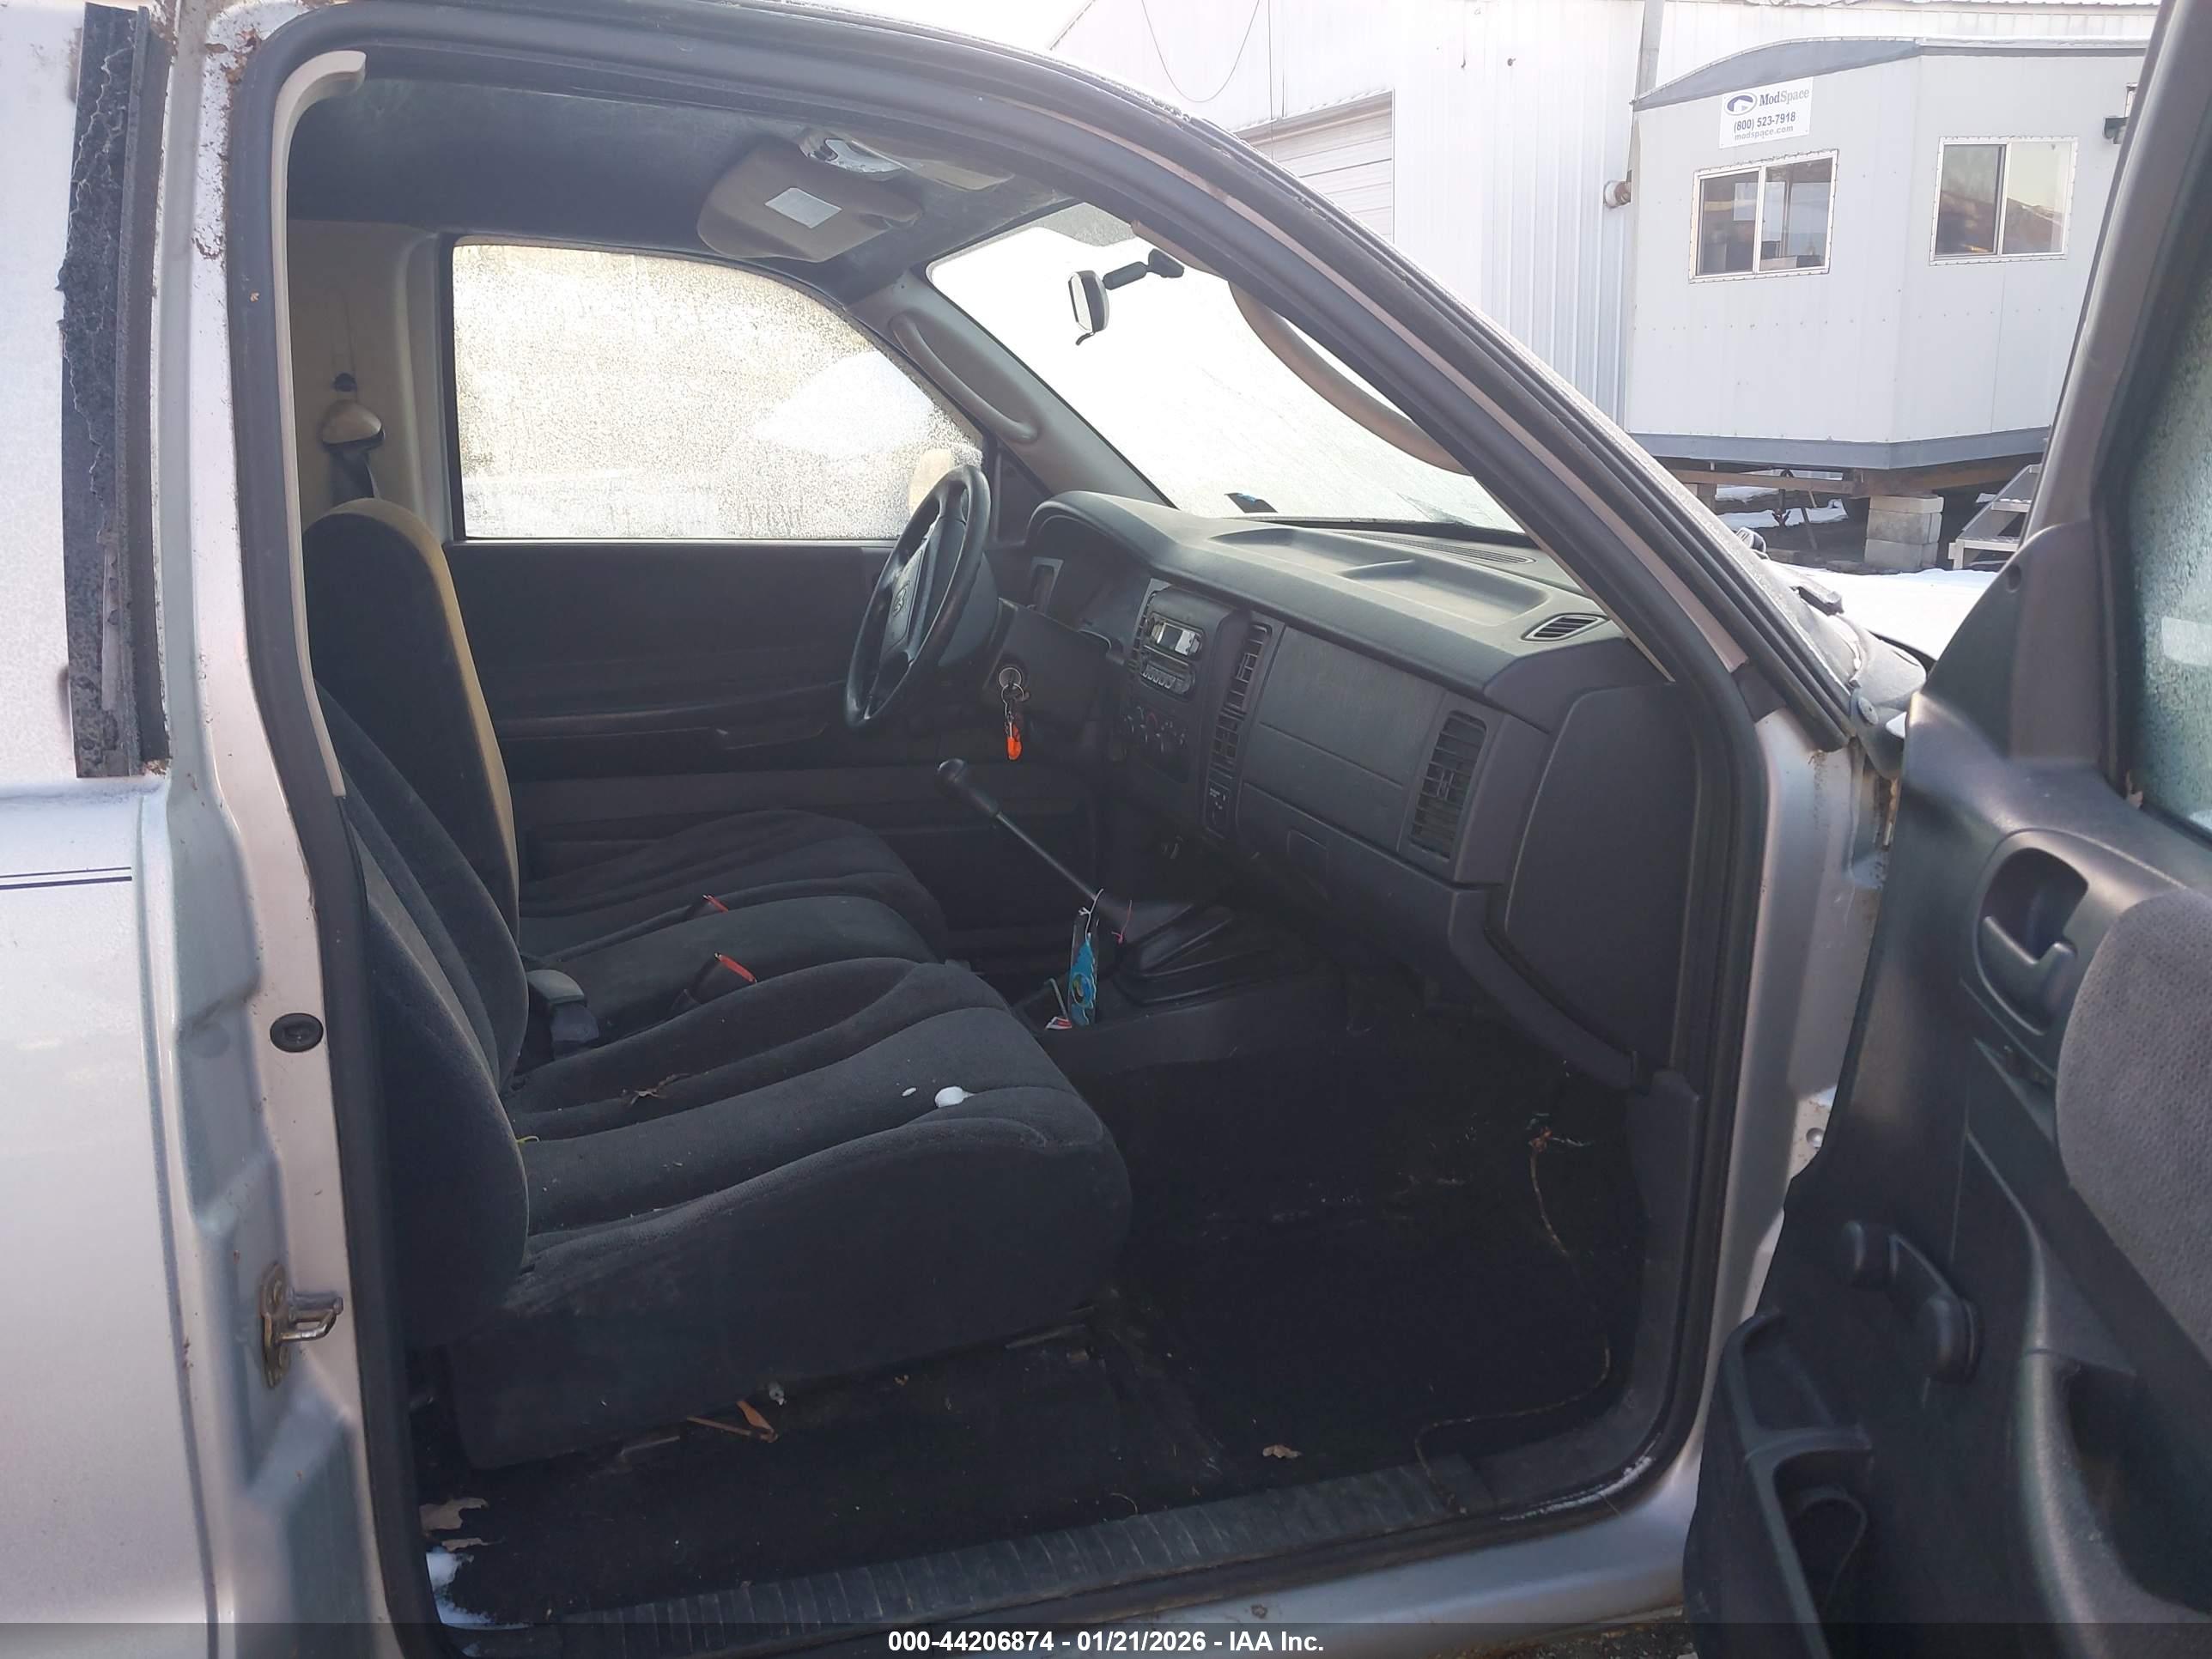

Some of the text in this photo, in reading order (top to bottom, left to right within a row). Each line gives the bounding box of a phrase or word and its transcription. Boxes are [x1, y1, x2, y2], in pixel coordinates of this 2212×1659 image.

[1759, 89, 1809, 106] ModSpace
[1734, 112, 1796, 133] (800) 523-7918
[1734, 125, 1794, 141] modspace.com
